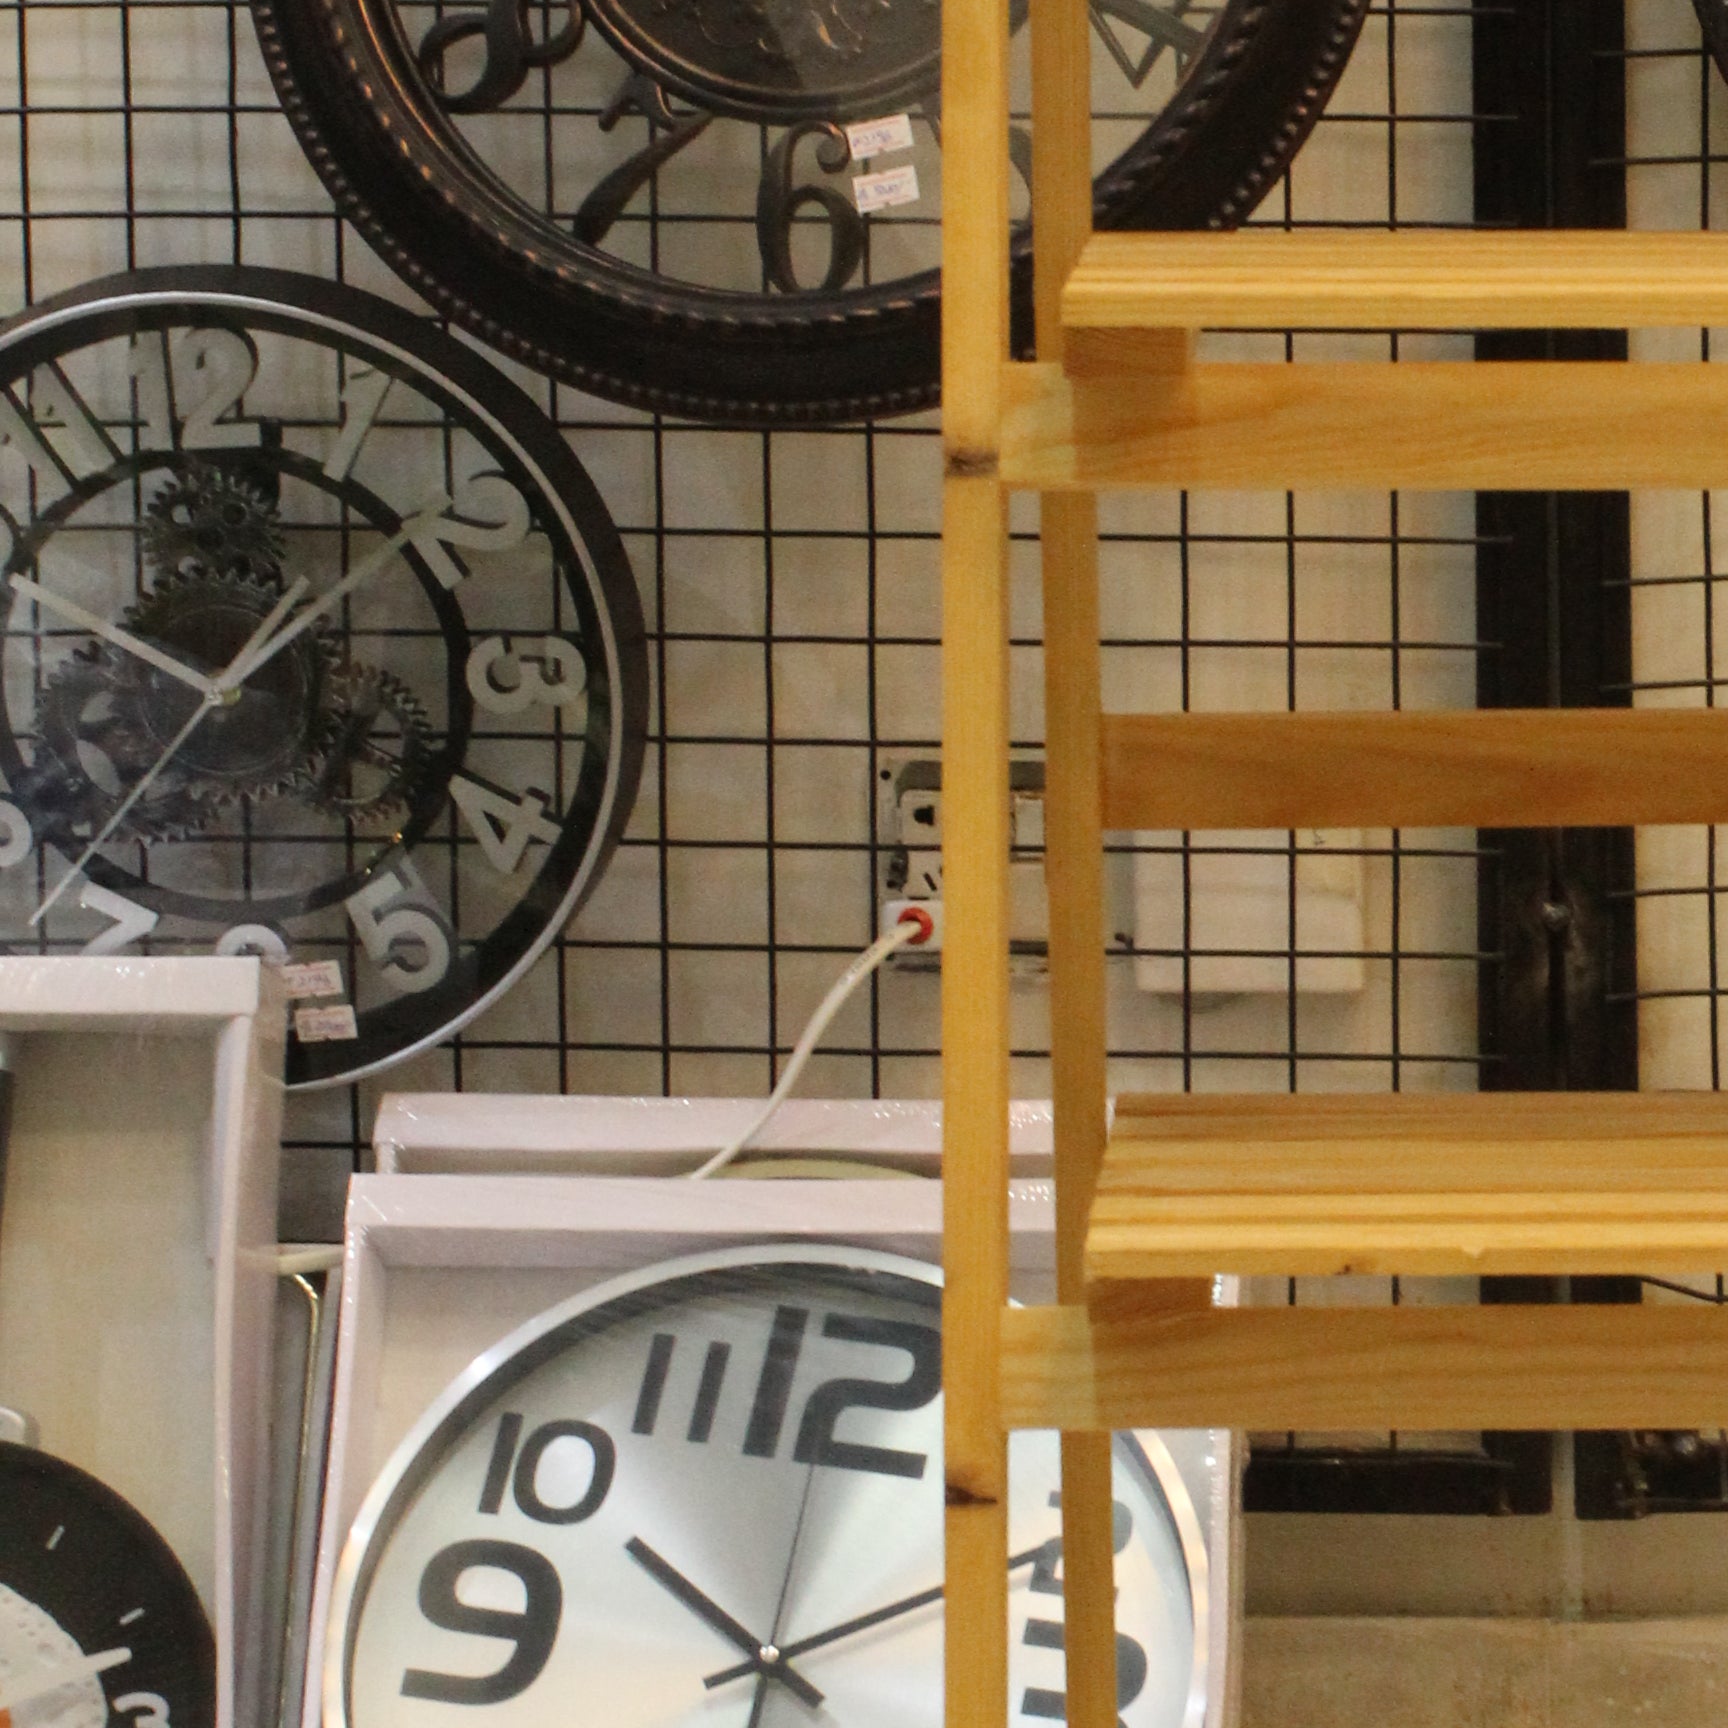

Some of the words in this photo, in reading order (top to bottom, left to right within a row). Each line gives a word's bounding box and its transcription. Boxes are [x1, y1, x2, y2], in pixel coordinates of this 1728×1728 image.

[573, 74, 715, 247] 7
[757, 121, 866, 295] 6
[127, 326, 262, 450] 12
[402, 472, 531, 590] 2
[466, 635, 587, 714] 3
[448, 770, 564, 874] 4
[344, 870, 451, 994] 5
[631, 1332, 733, 1445] 11
[738, 1302, 944, 1480] 12
[475, 1410, 617, 1526] 10
[399, 1538, 564, 1707] 9
